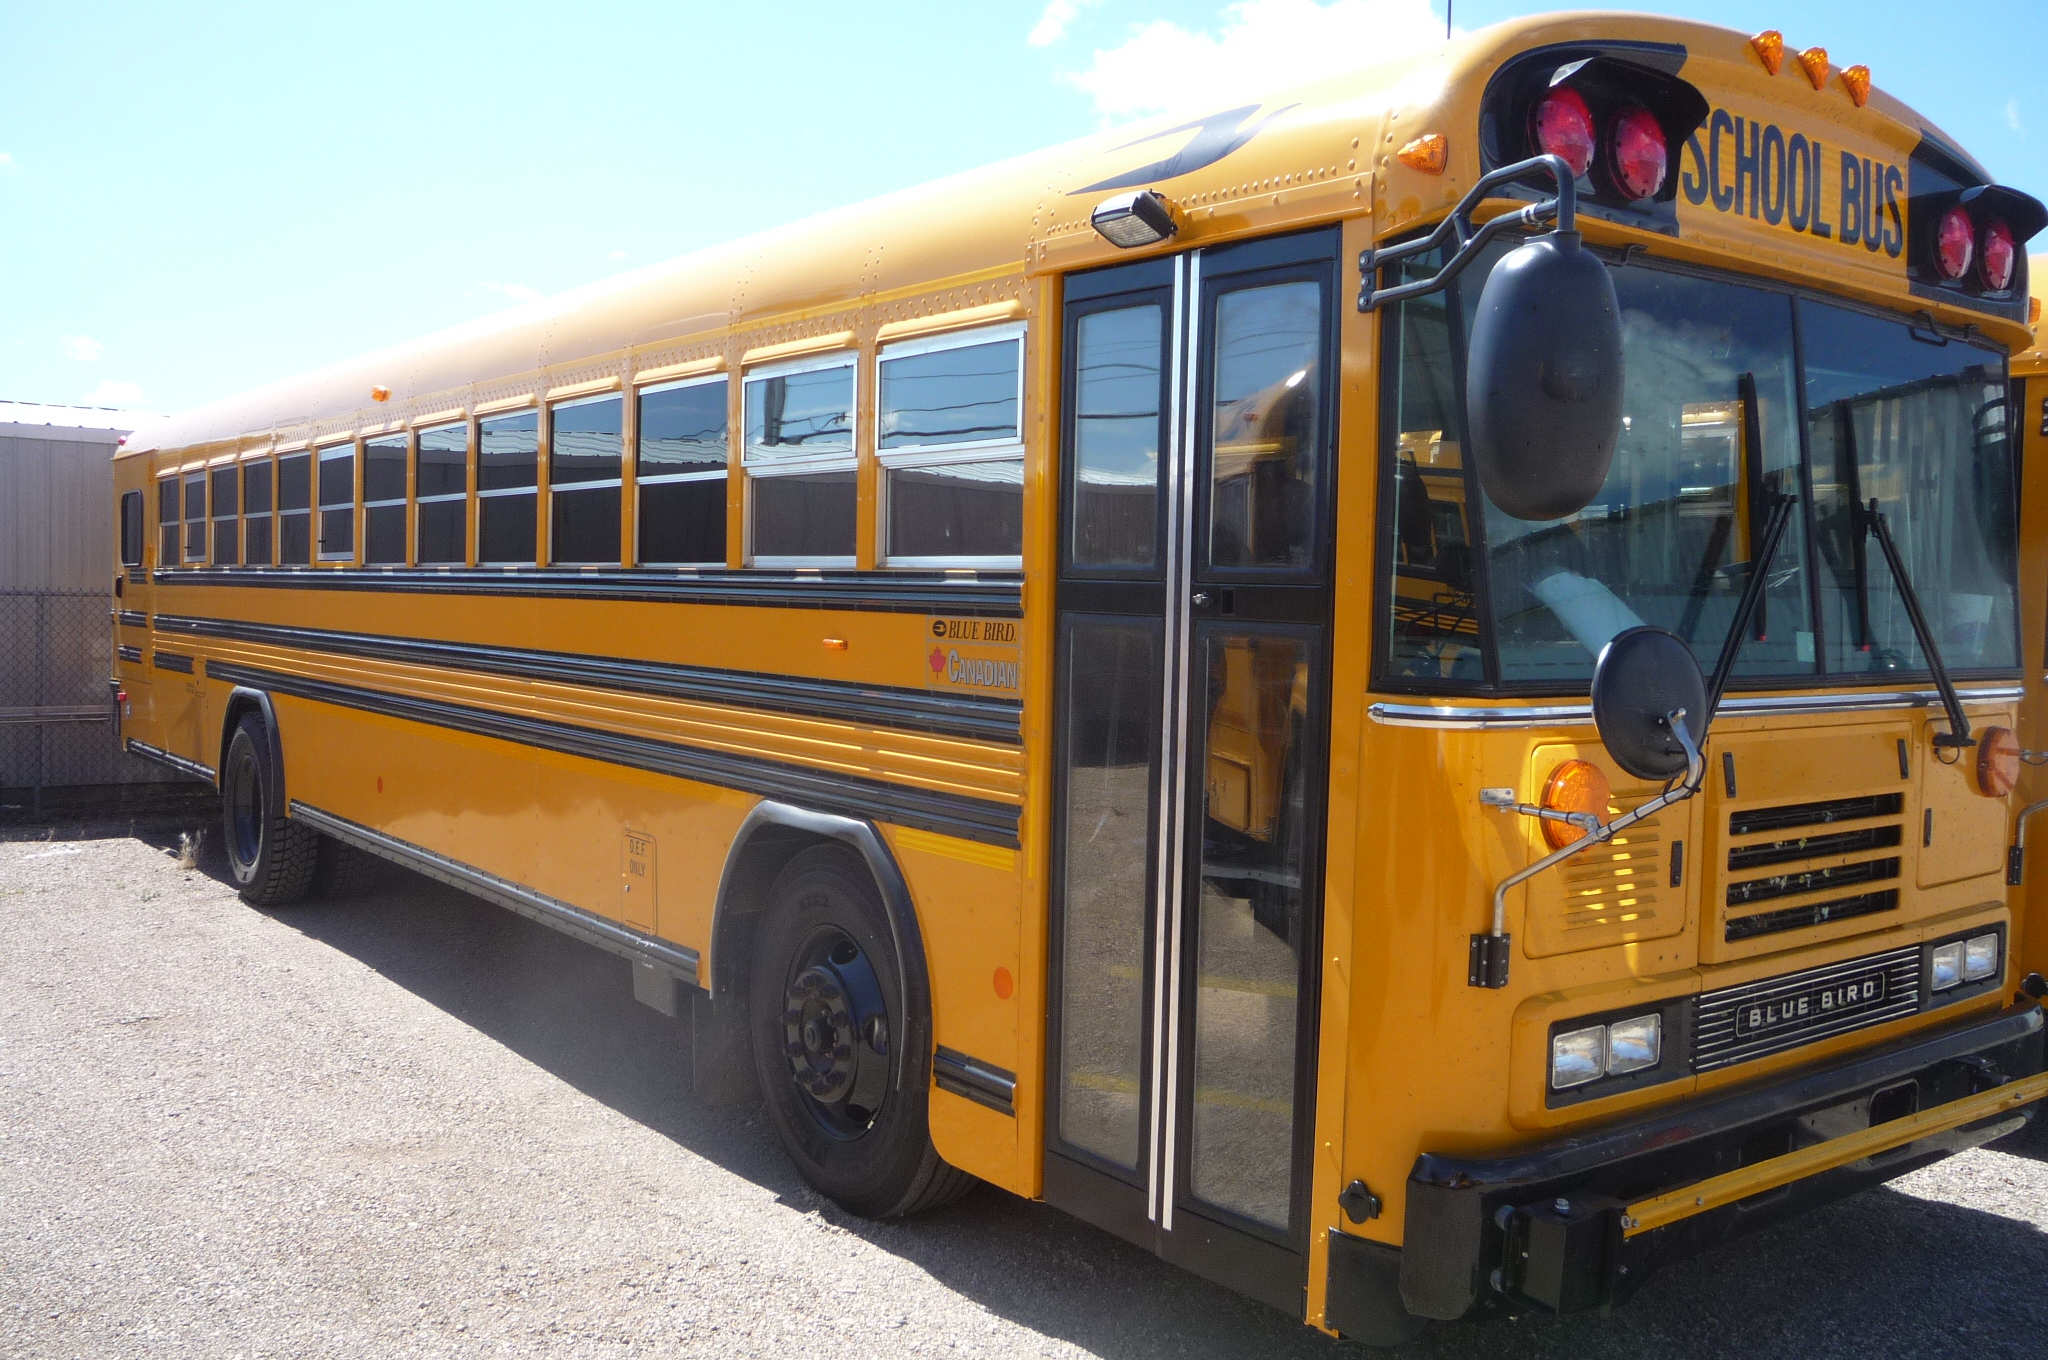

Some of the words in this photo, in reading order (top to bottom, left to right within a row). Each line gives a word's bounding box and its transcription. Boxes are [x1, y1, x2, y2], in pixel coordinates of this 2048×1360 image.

[1682, 108, 1831, 239] SCHOOL
[1839, 150, 1904, 258] BUS
[948, 620, 980, 640] BLUE
[629, 859, 646, 877] ONLY
[1749, 997, 1809, 1028] BLUE
[1821, 981, 1874, 1008] BIRD
